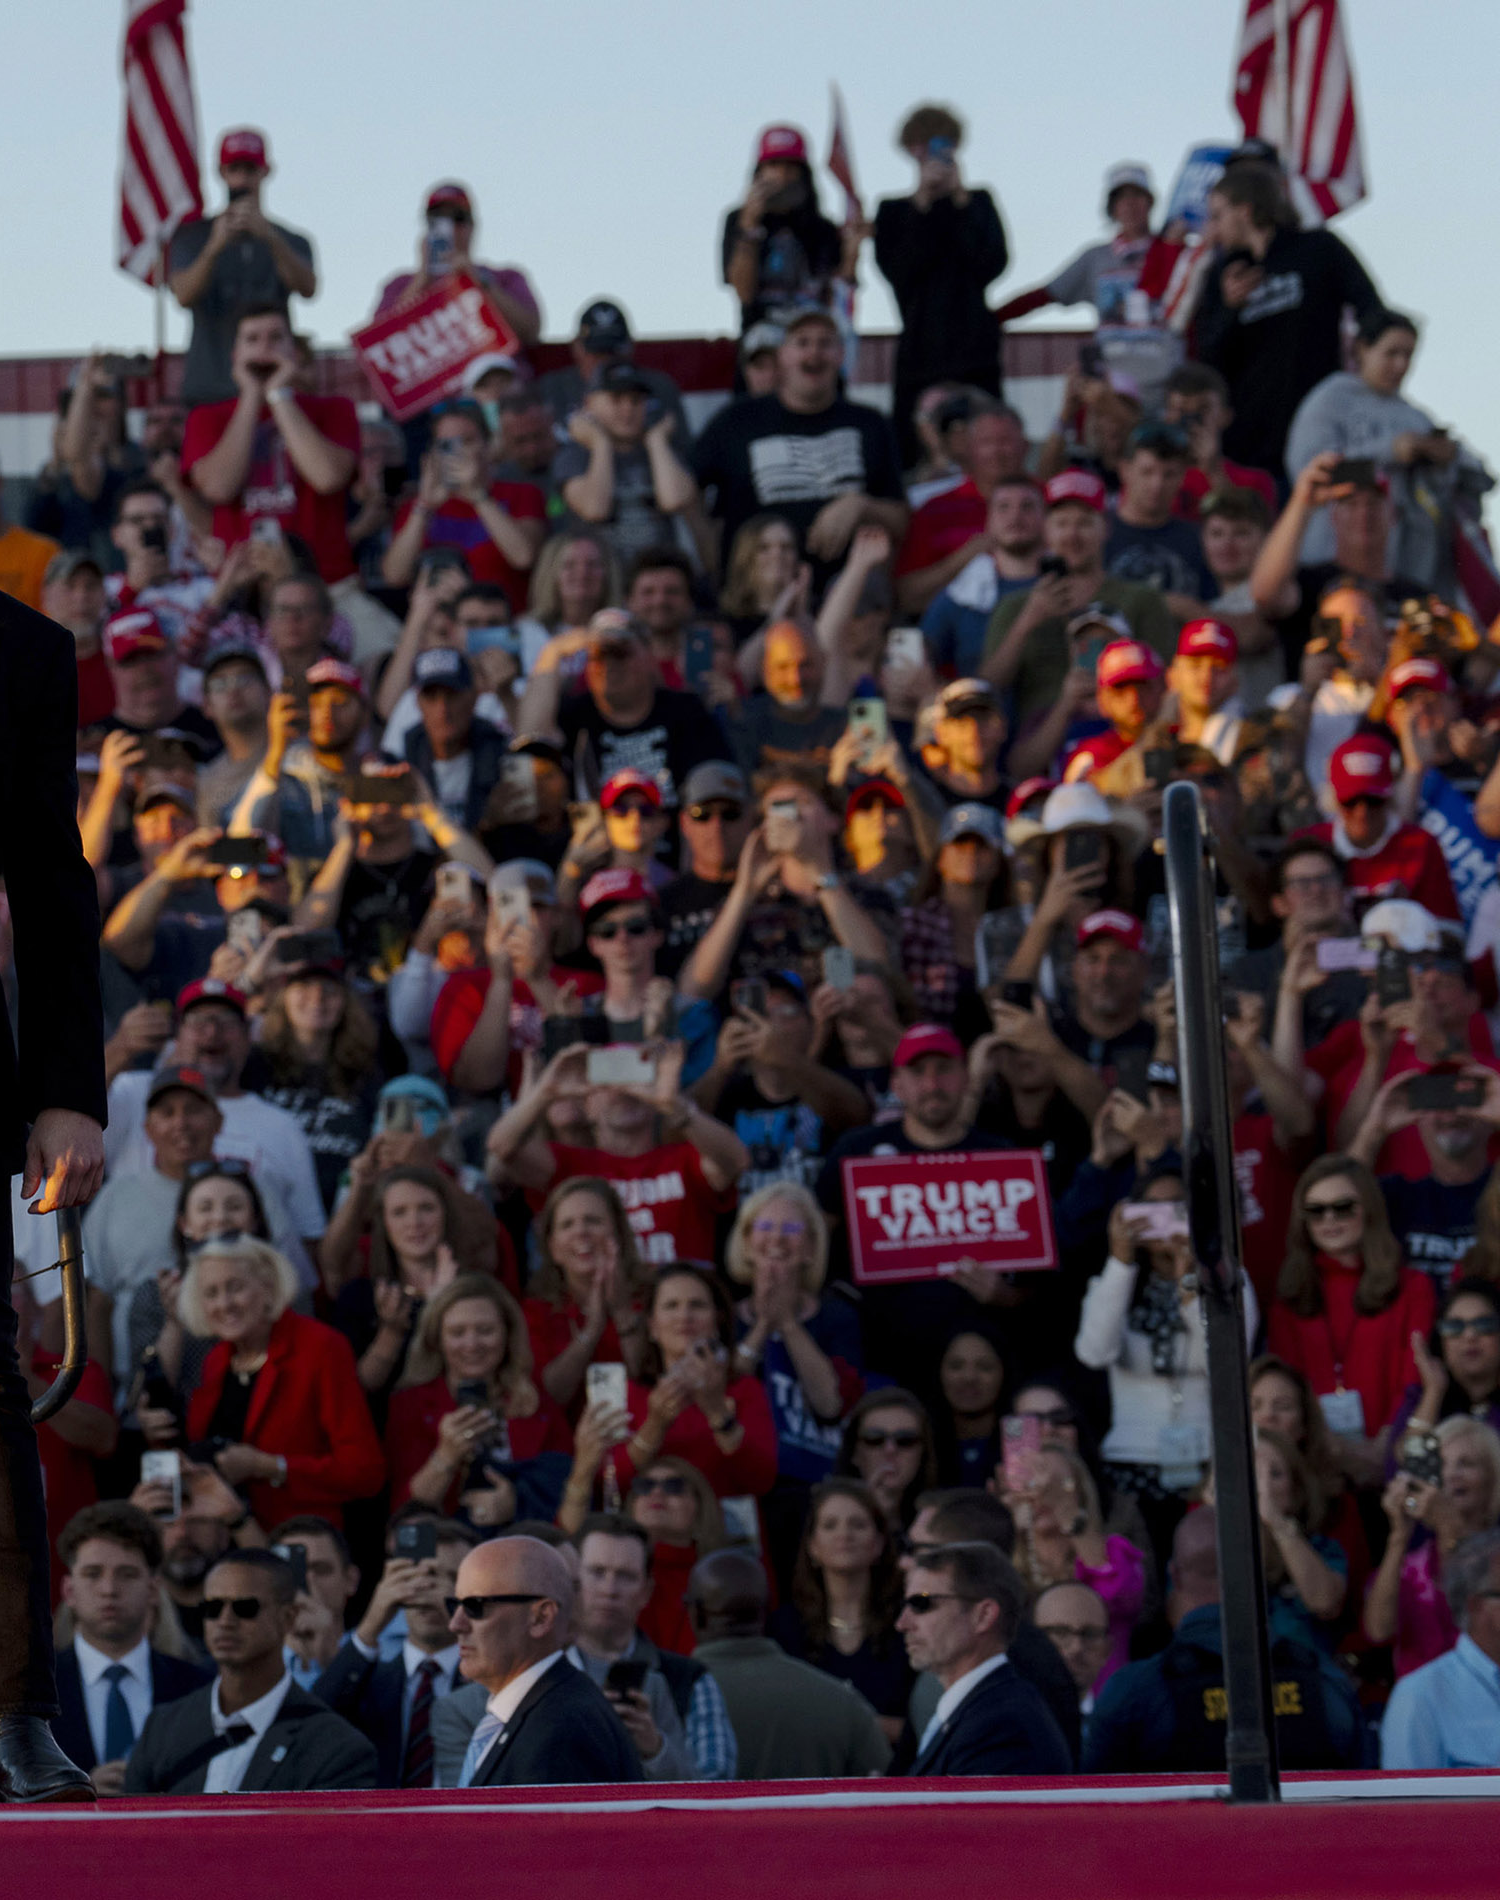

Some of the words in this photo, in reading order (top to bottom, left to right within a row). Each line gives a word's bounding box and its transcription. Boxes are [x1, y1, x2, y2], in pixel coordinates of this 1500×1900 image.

[856, 1177, 1035, 1219] TRUMP
[879, 1206, 1019, 1241] VANCE
[1407, 1231, 1476, 1260] TRU
[784, 1408, 841, 1448] VAN
